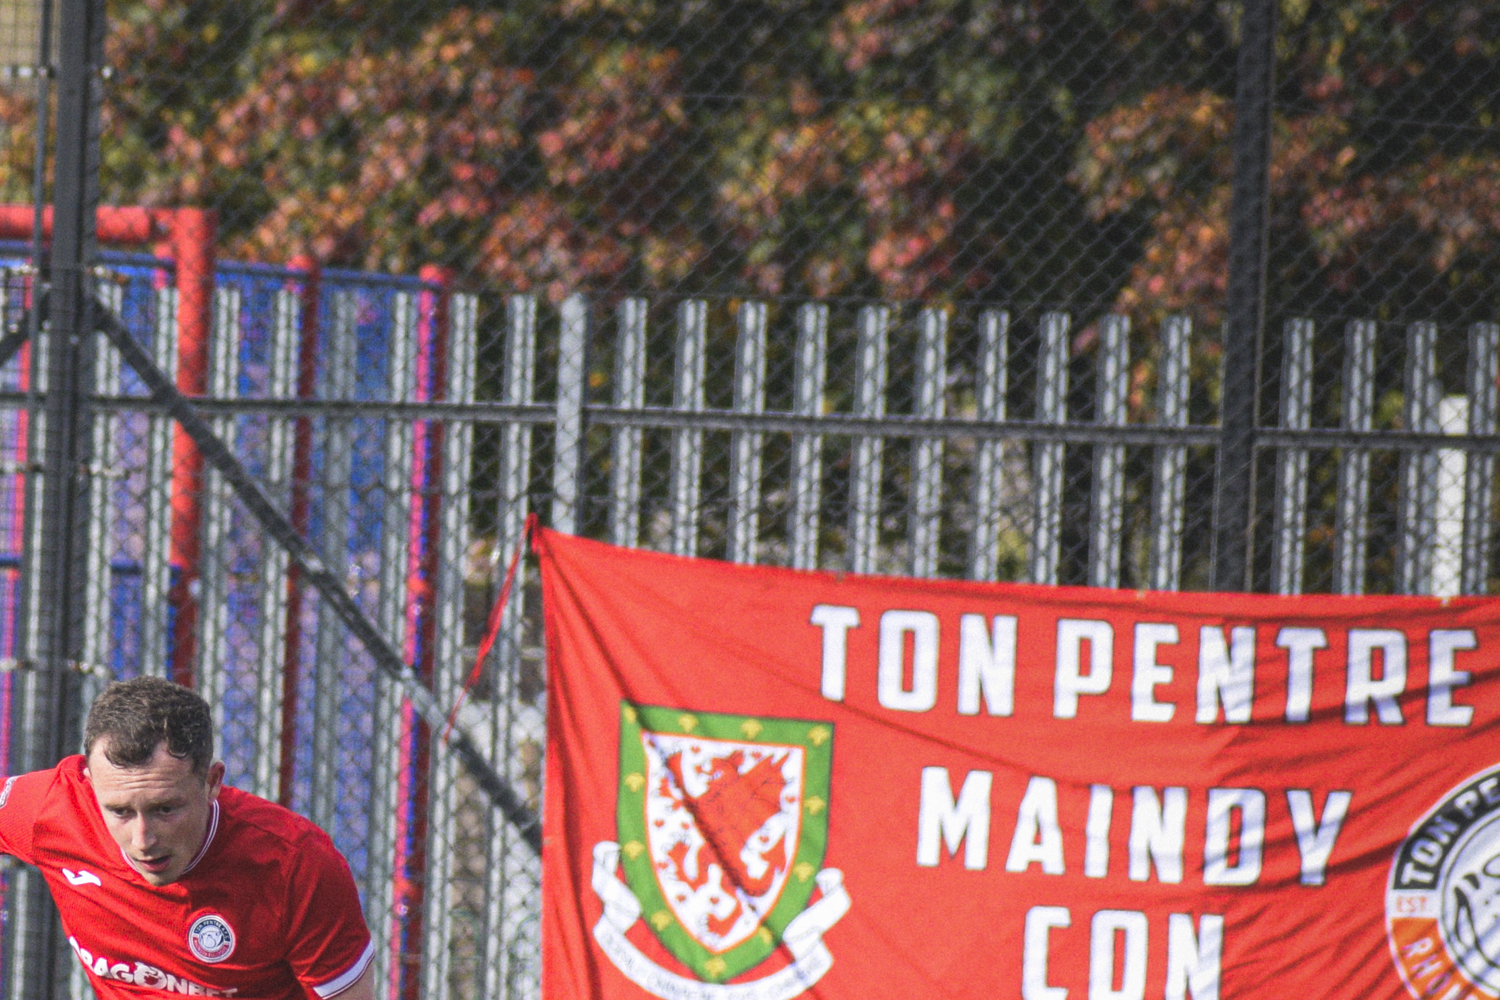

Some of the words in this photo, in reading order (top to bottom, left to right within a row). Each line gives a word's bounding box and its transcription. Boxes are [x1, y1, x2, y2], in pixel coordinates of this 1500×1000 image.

[810, 603, 1018, 717] TON
[1053, 618, 1477, 726] PENTRE
[916, 766, 1353, 886] MAINDY
[1401, 815, 1460, 885] TON
